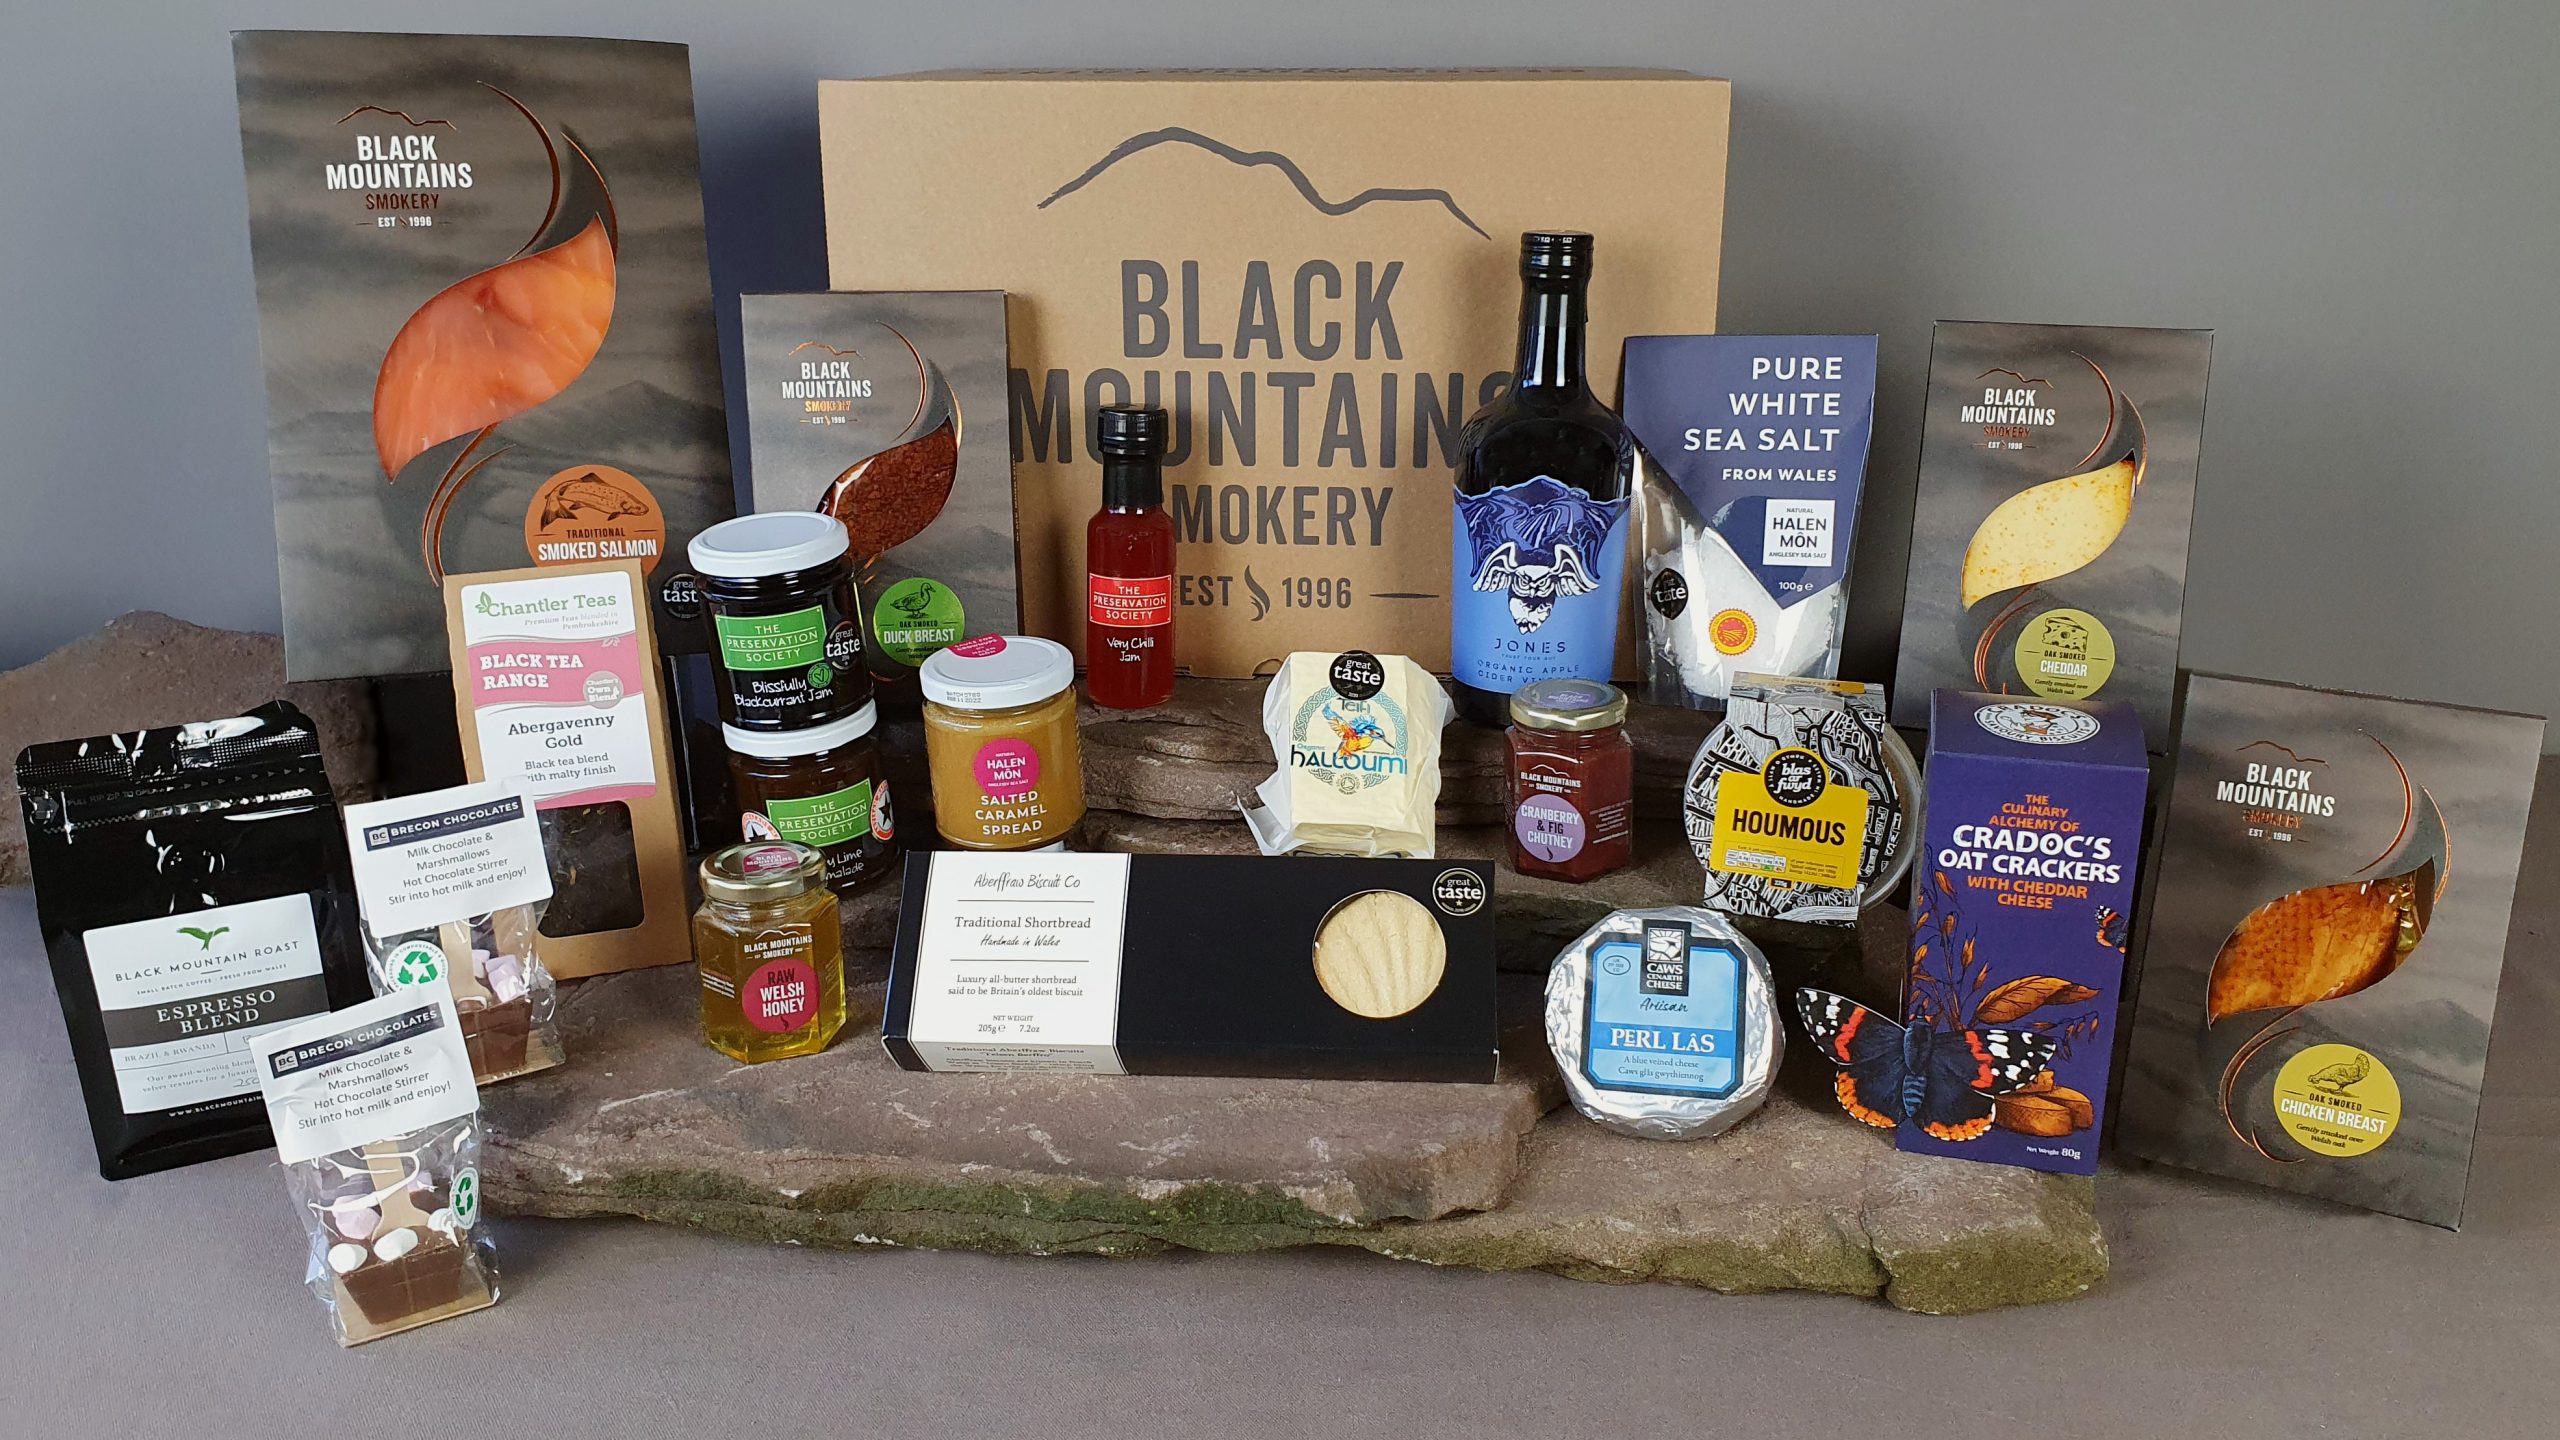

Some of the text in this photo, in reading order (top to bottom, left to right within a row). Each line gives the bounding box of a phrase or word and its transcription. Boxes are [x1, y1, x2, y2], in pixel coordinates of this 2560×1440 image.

[356, 135, 438, 161] BLACK
[326, 163, 473, 190] MOUNTAINS
[366, 193, 439, 210] SMOKERY
[378, 216, 396, 228] EST
[1121, 259, 1404, 361] BLACK
[801, 361, 850, 380] BLACK
[1752, 357, 1843, 380] PURE
[782, 380, 872, 399] MOUNTAINS
[1984, 388, 2037, 407] BLACK
[1728, 392, 1841, 416] WHITE
[1961, 405, 2056, 426] MOUNTAINS
[1683, 428, 1841, 451] SEA SALT
[1983, 425, 2031, 438] SMOKERY
[1722, 468, 1837, 482] FROM WALES
[1173, 484, 1394, 546] MOKERY
[1772, 517, 1827, 531] HALEN
[566, 528, 626, 539] TRADITIONAL
[1779, 532, 1818, 549] MÔN
[538, 539, 657, 561] SMOKED SALMON
[1118, 586, 1140, 595] THE
[1180, 575, 1352, 609] EST 1996
[486, 594, 617, 618] Chantler Teas
[1093, 594, 1166, 608] PRESERVATION
[1106, 609, 1152, 620] SOCIETY
[755, 624, 780, 634] THE
[835, 628, 854, 643] great
[883, 628, 955, 644] DUCK BREAST
[727, 630, 818, 649] PRESERVATION
[825, 637, 861, 658] taste
[1106, 636, 1154, 650] Very Chilli
[1494, 638, 1567, 653] JONES
[480, 653, 584, 670] BLACK TEA
[746, 648, 801, 662] SOCIETY
[1119, 650, 1141, 662] Jam
[2044, 649, 2086, 661] OAK SMOKED
[1345, 659, 1372, 670] great
[1477, 659, 1580, 674] ORGANIC APPLE
[2040, 660, 2088, 677] CHEDDAR
[482, 673, 549, 690] RANGE
[1334, 665, 1381, 686] taste
[1478, 669, 1513, 684] CIDER
[752, 677, 807, 694] Blissfully
[734, 688, 834, 708] Blackcurrant Jam
[508, 715, 615, 736] Abergavenny
[545, 734, 583, 749] Gold
[525, 752, 609, 770] Black tea blend
[987, 756, 1026, 769] HALEN
[549, 764, 617, 782] malty finish
[1520, 771, 1542, 782] BLACK
[1542, 775, 1581, 788] MOUNTAINS
[2246, 762, 2313, 791] BLACK
[1536, 783, 1563, 794] SMOKERY
[981, 790, 1038, 806] SALTED
[2025, 794, 2049, 805] THE
[2216, 780, 2336, 817] MOUNTAINS
[811, 801, 836, 813] THE
[975, 804, 1048, 821] CARAMEL
[1520, 804, 1580, 825] CRANBERRY
[2002, 802, 2069, 818] CULINARY
[372, 801, 519, 841] BC BRECON CHOCOLATES
[779, 802, 868, 830] PRESERVATION
[1989, 815, 2080, 832] ALCHEMY OF
[800, 821, 853, 842] SOCIETY
[982, 820, 1043, 835] SPREAD
[1536, 819, 1564, 835] & FIG
[1732, 808, 1847, 846] HOUMOUS
[2248, 827, 2263, 838] EST
[407, 832, 494, 859] Milk Chocolate &
[1527, 830, 1573, 849] CHUTNEY
[1952, 824, 2112, 860] CRADOC'S
[416, 847, 491, 872] Marshmallows
[1938, 849, 2122, 884] OAT CRACKERS
[403, 857, 508, 888] Hot Chocolate Stirrer
[388, 865, 528, 905] Stir into hot milk and enjoy!
[973, 872, 1081, 892] Aberffraw Biscuit Co
[1447, 878, 1471, 888] great
[1967, 875, 2088, 899] WITH CHEDDAR
[1437, 886, 1482, 900] taste
[1997, 893, 2053, 909] CHEESE
[954, 916, 1091, 929] Traditional Shortbread
[744, 934, 813, 953] BLACK MOUNTAINS
[980, 934, 1061, 947] Handmade in Wales
[115, 940, 300, 982] BLACK MOUNTAIN ROAST
[1646, 962, 1683, 974] CAWS
[767, 967, 795, 985] RAW
[956, 975, 1077, 985] Luxury all-butter shortbread
[760, 981, 805, 1002] WELSH
[948, 987, 1083, 997] said to be Britain's oldest biscuit
[1646, 980, 1683, 991] CHEESE
[156, 989, 277, 1023] ESPRESSO
[762, 998, 805, 1018] HONEY
[180, 1008, 260, 1034] BLEND
[278, 1009, 438, 1067] BC BRECON CHOCOLATES
[1610, 1027, 1666, 1050] PERL
[1632, 1056, 1648, 1064] blue
[1649, 1058, 1674, 1067] veined
[1675, 1058, 1699, 1068] cheese
[2309, 1092, 2362, 1112] OAK SMOKED
[2280, 1098, 2387, 1134] CHICKEN BREAST
[2061, 1147, 2082, 1160] 80g
